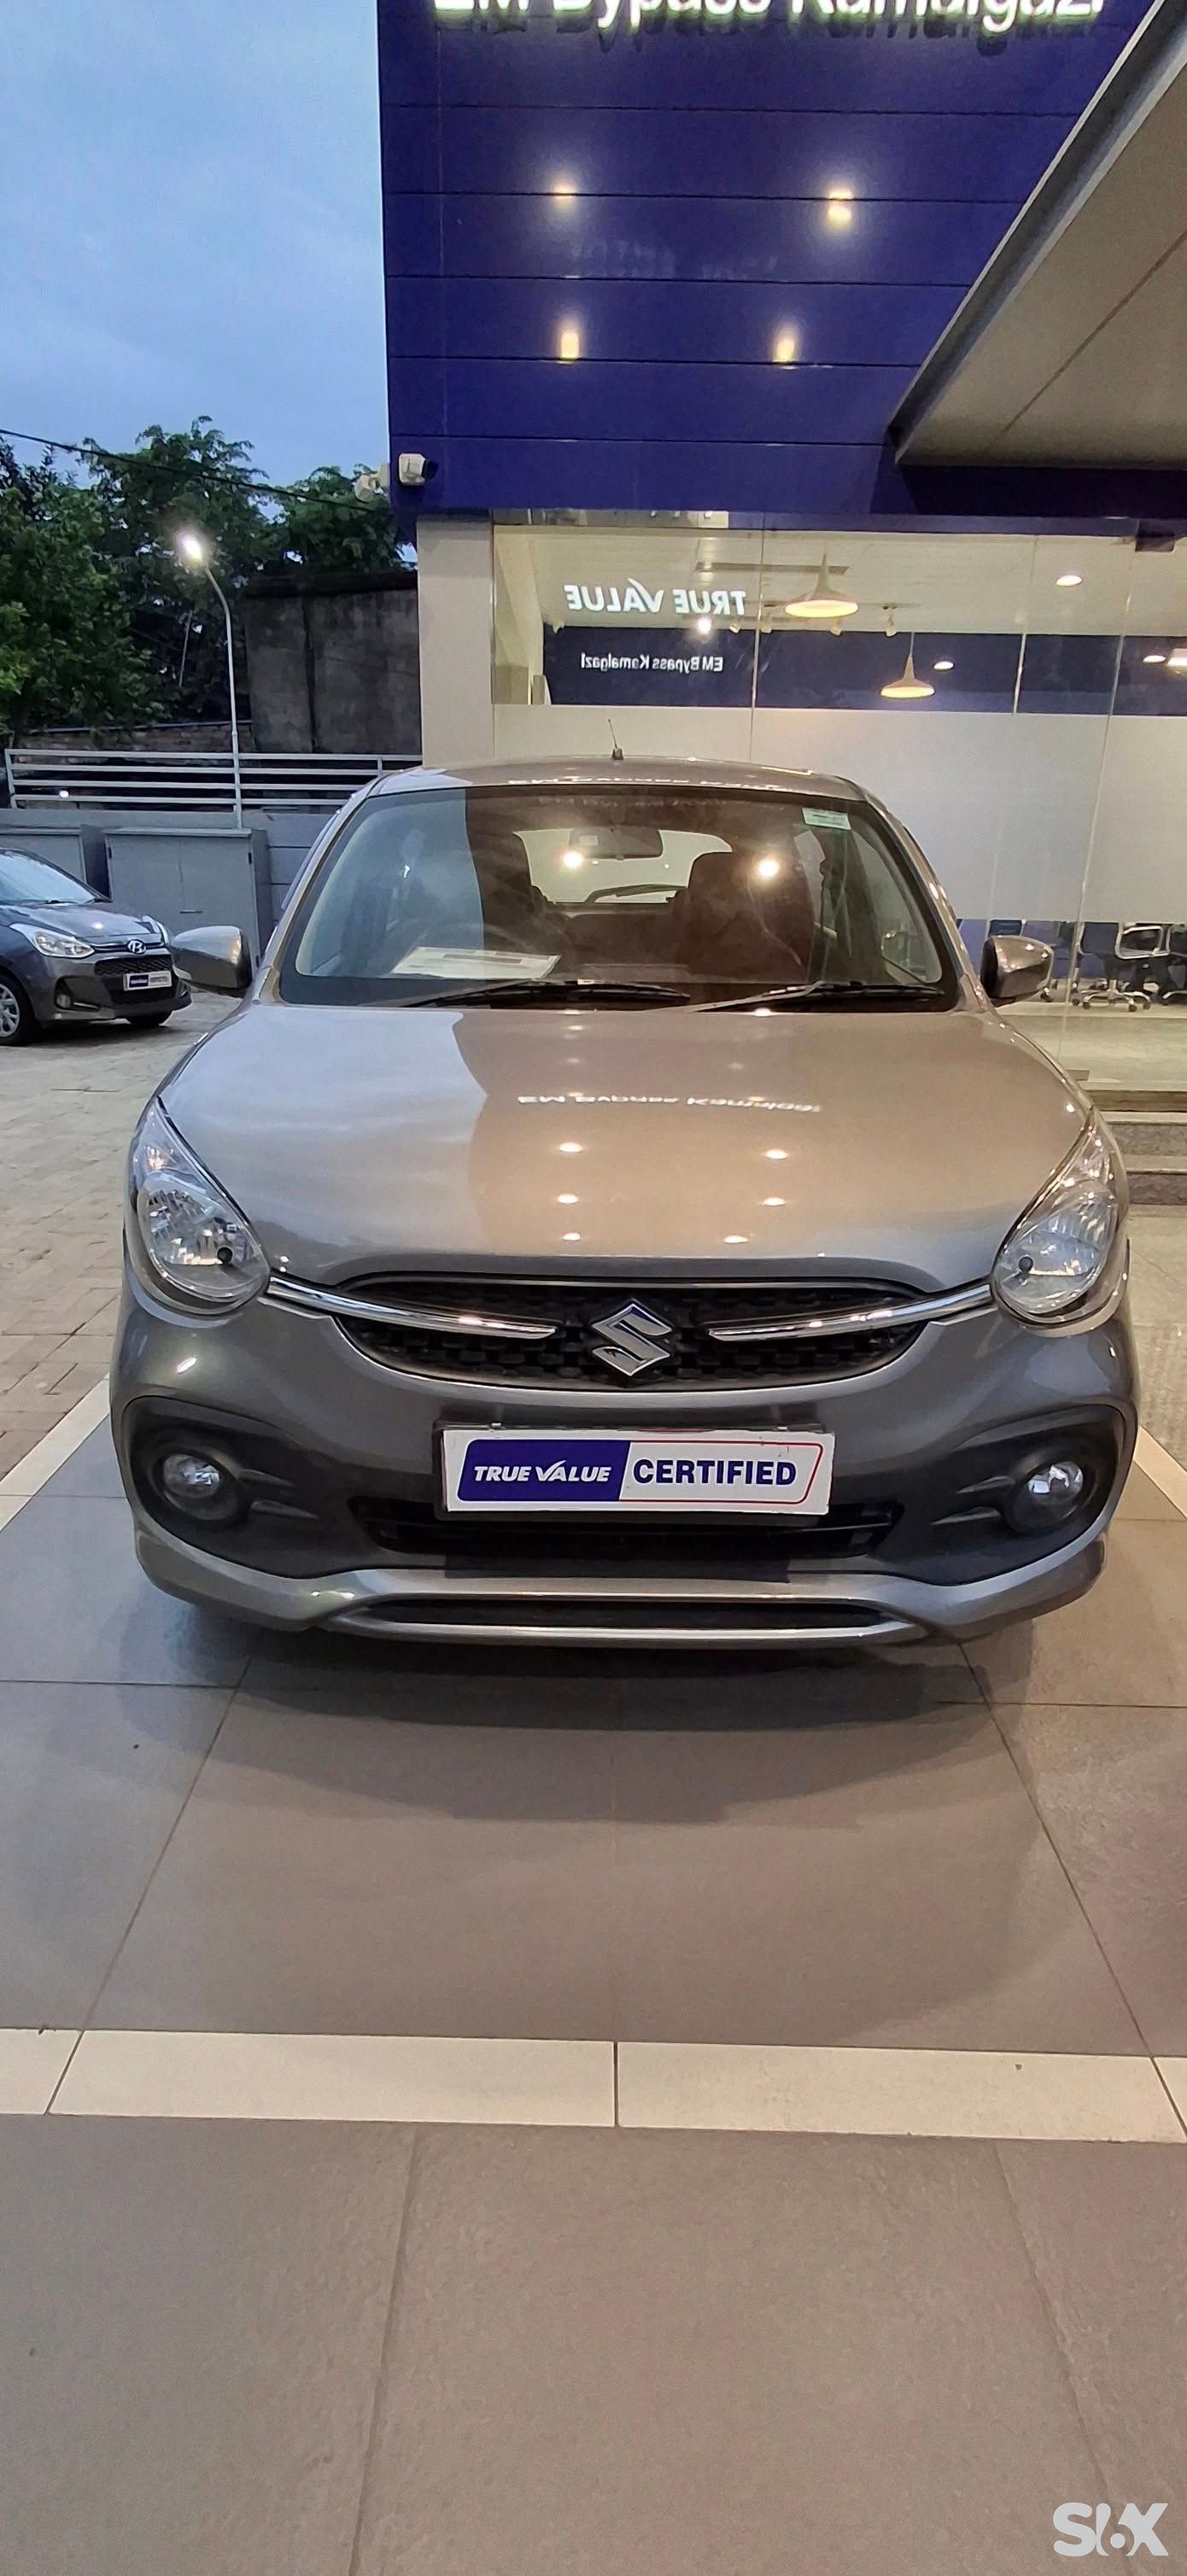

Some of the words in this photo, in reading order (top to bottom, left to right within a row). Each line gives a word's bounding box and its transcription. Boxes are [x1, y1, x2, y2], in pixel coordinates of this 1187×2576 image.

[474, 1466, 532, 1481] TRUE
[535, 1459, 612, 1482] VALUE
[633, 1458, 797, 1486] CERTIFIED
